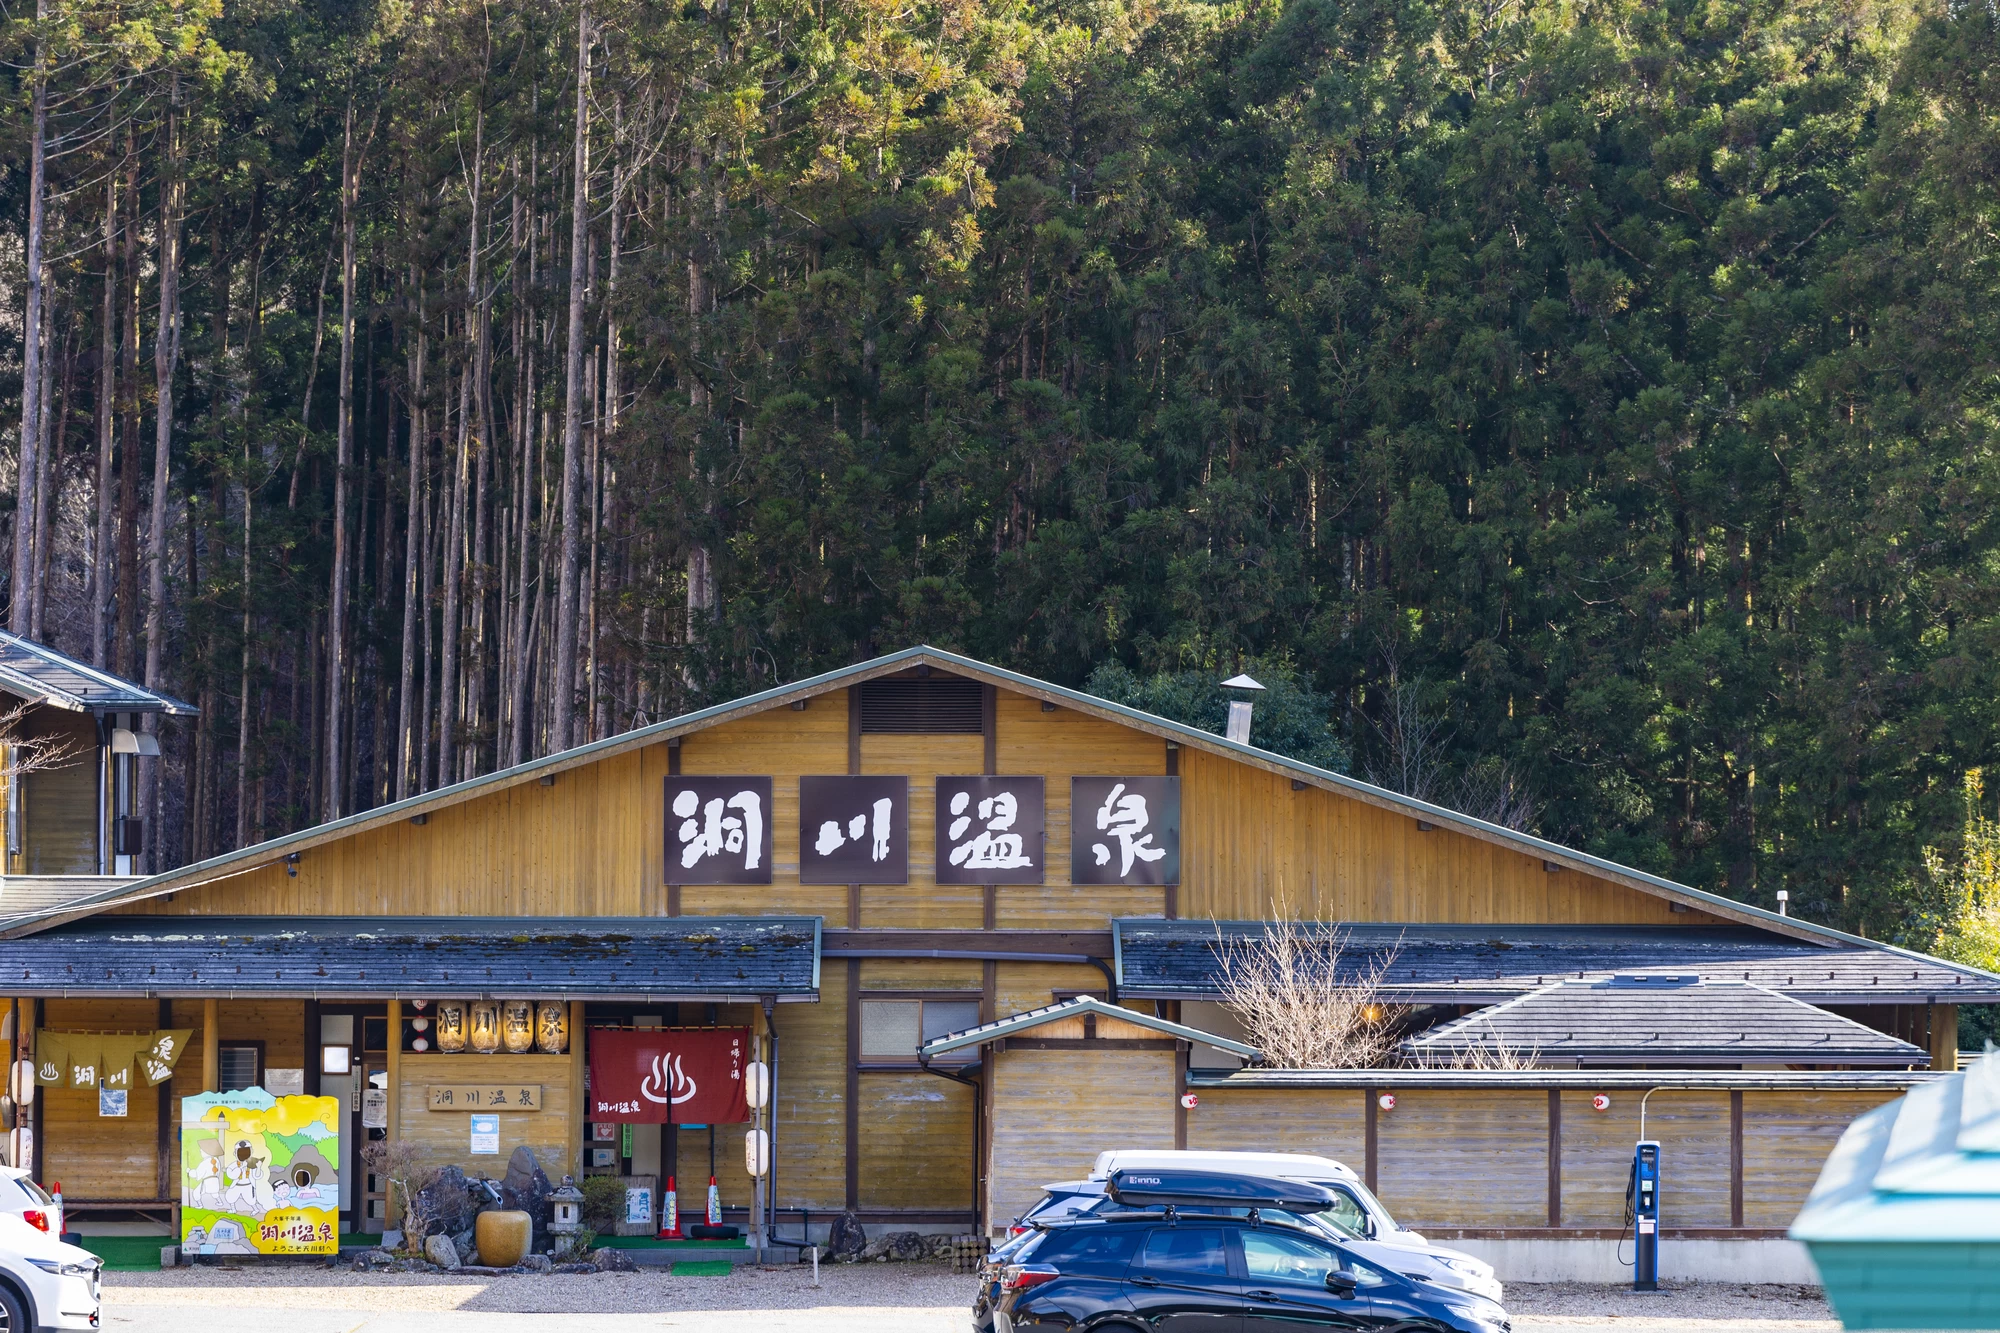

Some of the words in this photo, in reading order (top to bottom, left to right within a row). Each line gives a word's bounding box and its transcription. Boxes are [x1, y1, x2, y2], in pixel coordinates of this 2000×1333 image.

[673, 784, 1166, 877] 洞川温泉
[439, 1006, 564, 1036] 洞川温泉
[731, 1038, 740, 1080] 日帰り湯
[436, 1089, 534, 1106] 洞川温泉
[598, 1100, 640, 1113] 洞川温泉
[260, 1222, 334, 1243] 洞川温泉
